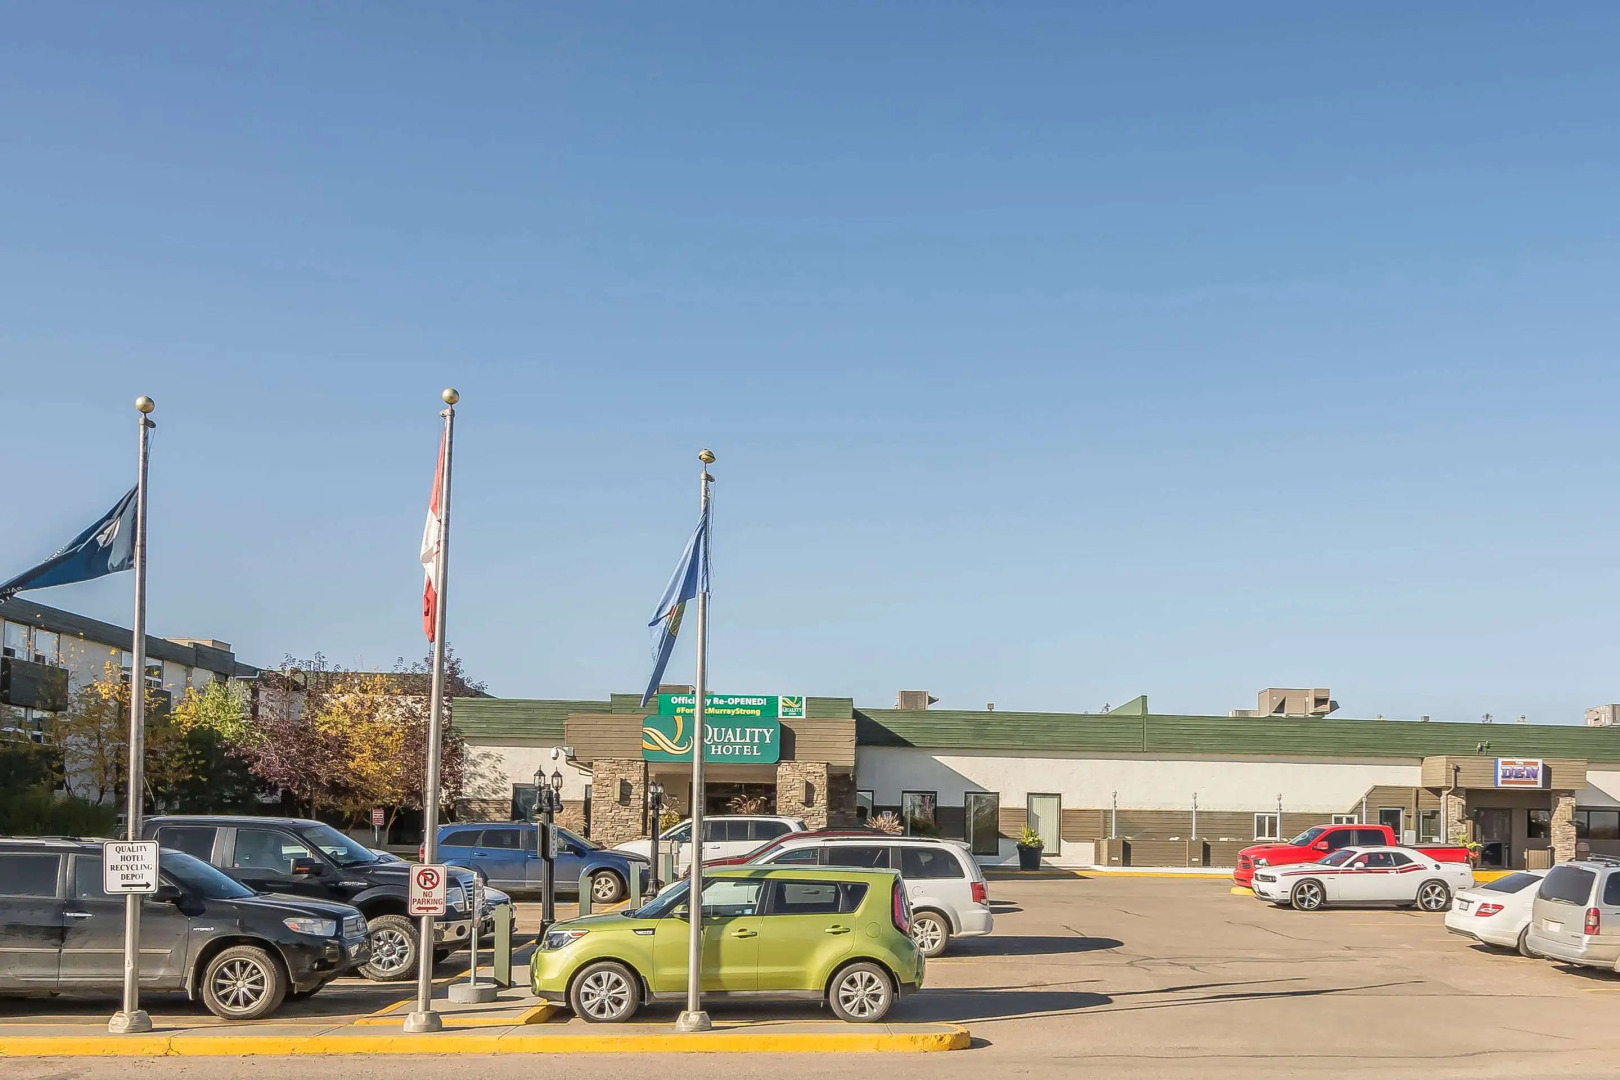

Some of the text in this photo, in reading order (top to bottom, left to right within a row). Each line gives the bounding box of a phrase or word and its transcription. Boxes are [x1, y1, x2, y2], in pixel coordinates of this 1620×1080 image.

[713, 697, 767, 706] Re-OPENED!
[704, 723, 775, 744] QUALITY
[710, 745, 762, 756] HOTEL
[1501, 766, 1539, 779] DEN
[115, 846, 147, 854] QUALITY
